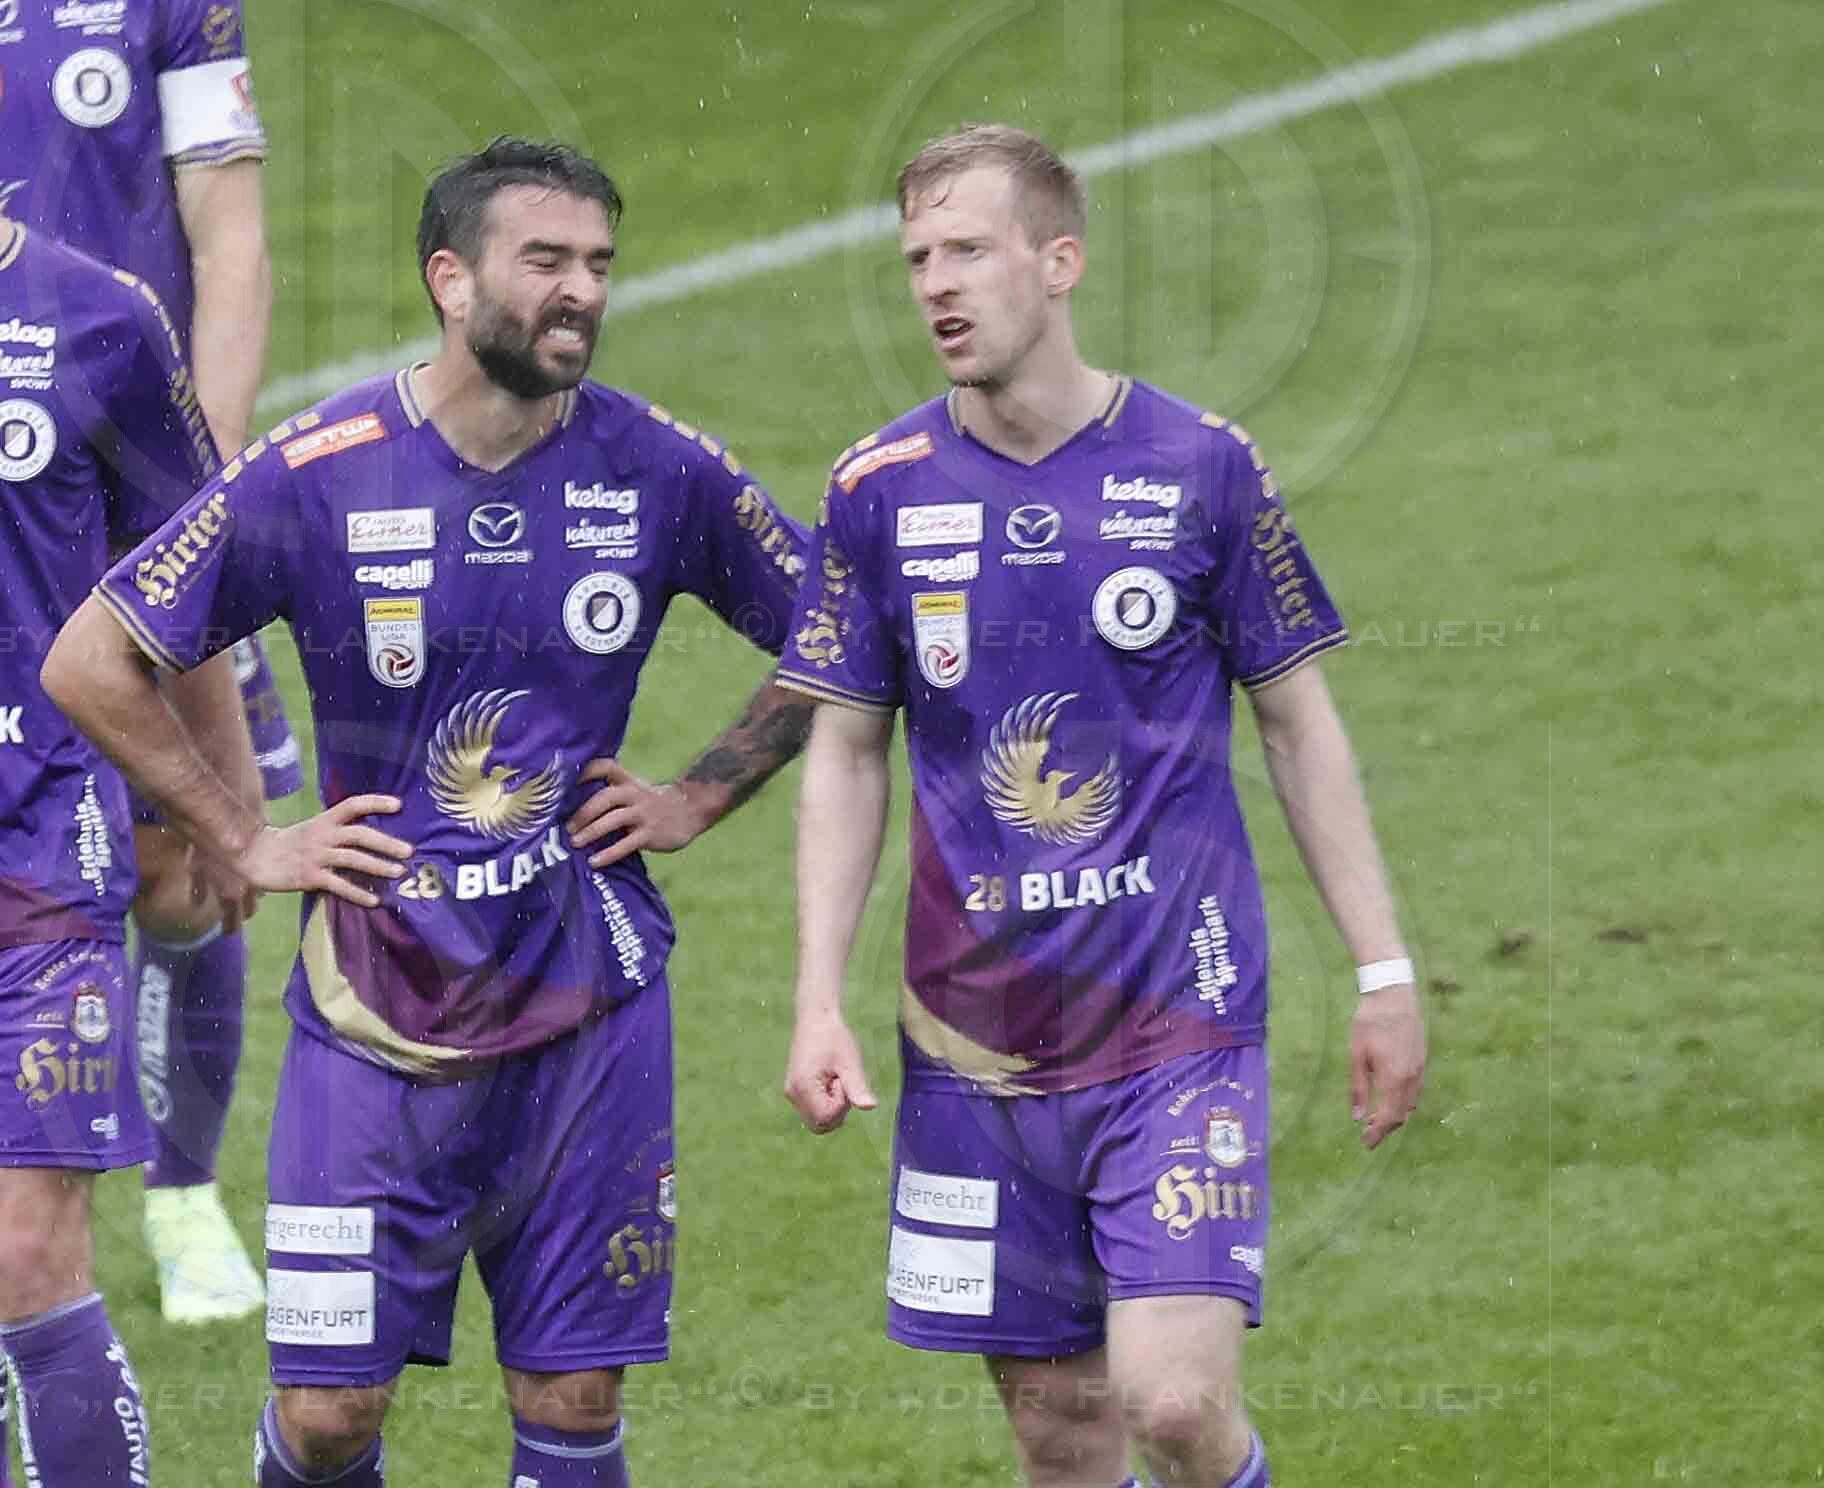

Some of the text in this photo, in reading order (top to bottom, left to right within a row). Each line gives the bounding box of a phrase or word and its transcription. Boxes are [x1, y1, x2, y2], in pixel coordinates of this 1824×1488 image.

[564, 480, 640, 514] kelag
[1101, 473, 1182, 509] kelag
[355, 558, 435, 588] capelli
[464, 550, 532, 564] mazda
[370, 622, 418, 633] BUNDES
[965, 855, 1156, 913] 28 BLACK
